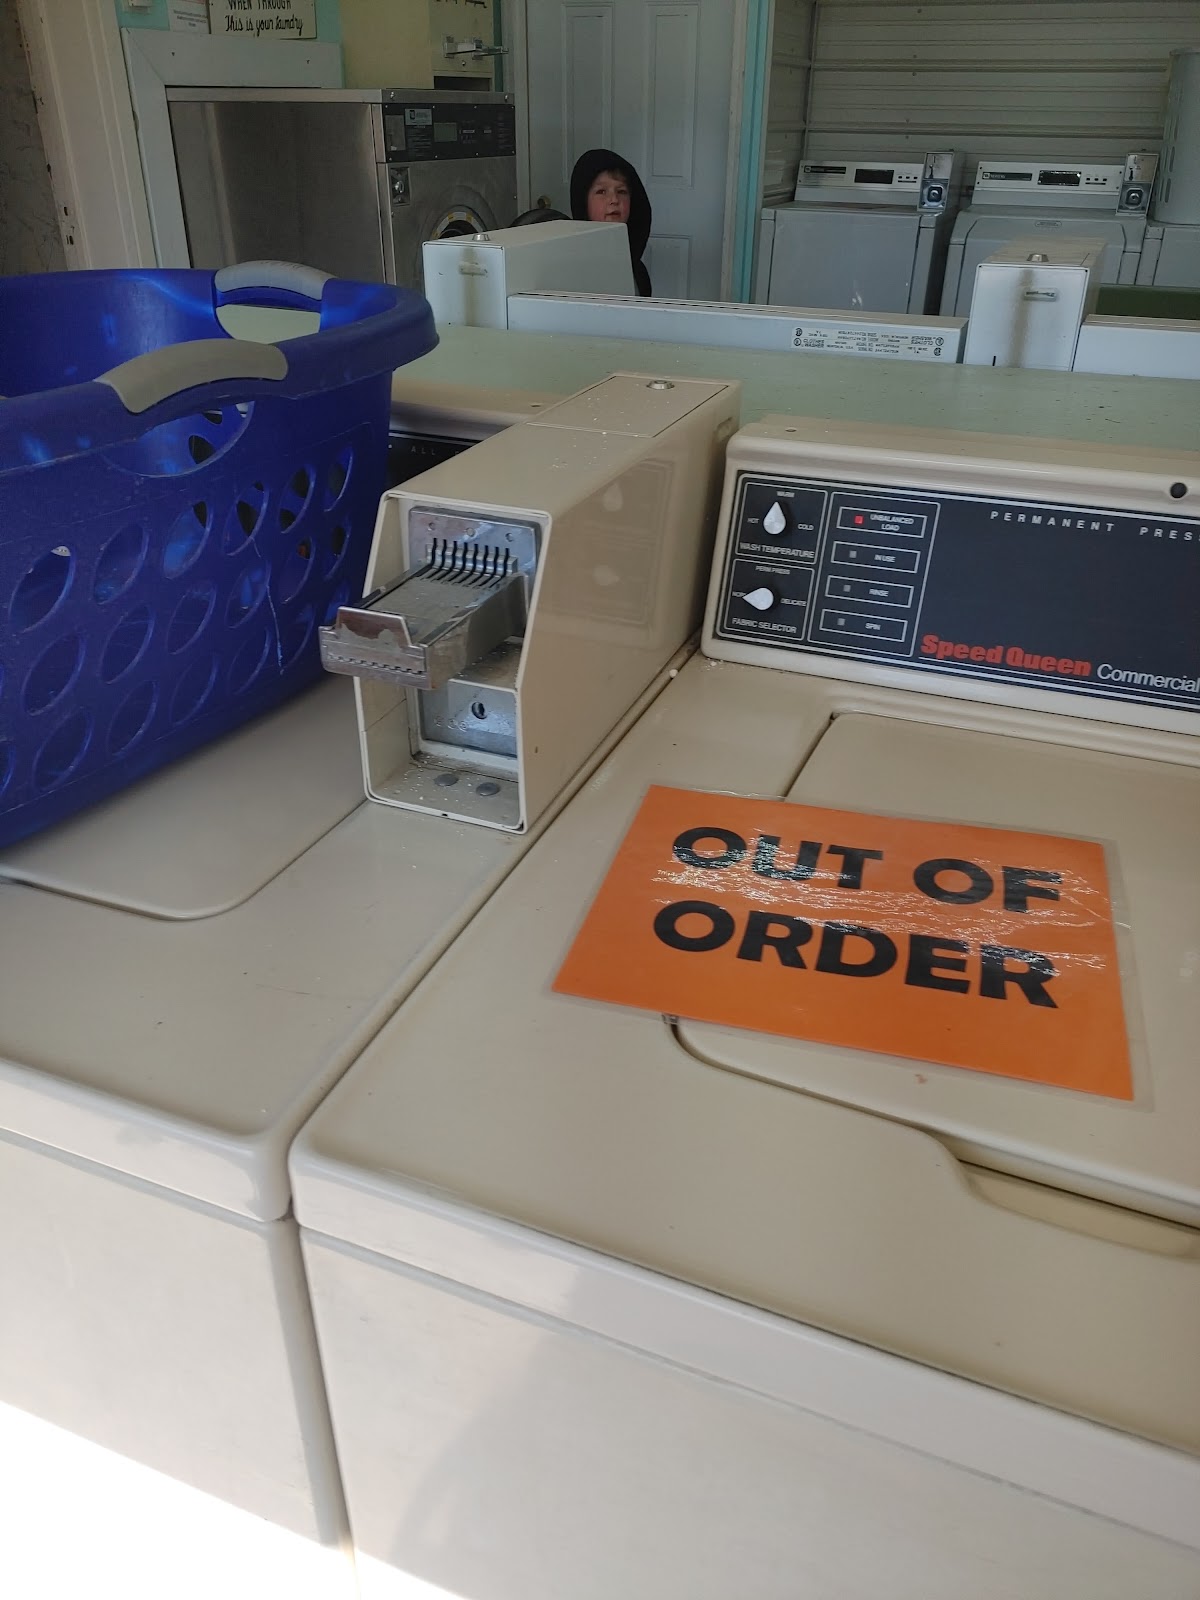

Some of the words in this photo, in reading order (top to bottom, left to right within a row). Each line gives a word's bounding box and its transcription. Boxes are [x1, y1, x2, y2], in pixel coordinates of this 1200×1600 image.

[228, 0, 252, 10] WHEN
[225, 15, 243, 31] This
[246, 17, 254, 31] is
[869, 513, 915, 525] UNBALANCED
[797, 523, 815, 531] COLD
[881, 523, 900, 532] LOAD
[990, 510, 1114, 532] PERMANENT
[1139, 526, 1200, 543] PRES
[739, 542, 761, 552] WASH
[761, 544, 816, 559] TEMPERATURE
[874, 554, 882, 562] IN
[881, 555, 897, 563] USE
[868, 588, 889, 597] RINSE
[780, 598, 807, 606] DELICATE
[732, 617, 758, 628] FABRIC
[758, 621, 797, 634] SELECTOR
[864, 622, 882, 631] SPIN
[921, 634, 1004, 664] Speed
[1005, 646, 1092, 677] Queen
[671, 826, 883, 890] OUT
[912, 857, 1063, 913] OF
[653, 900, 1060, 1009] ORDER
